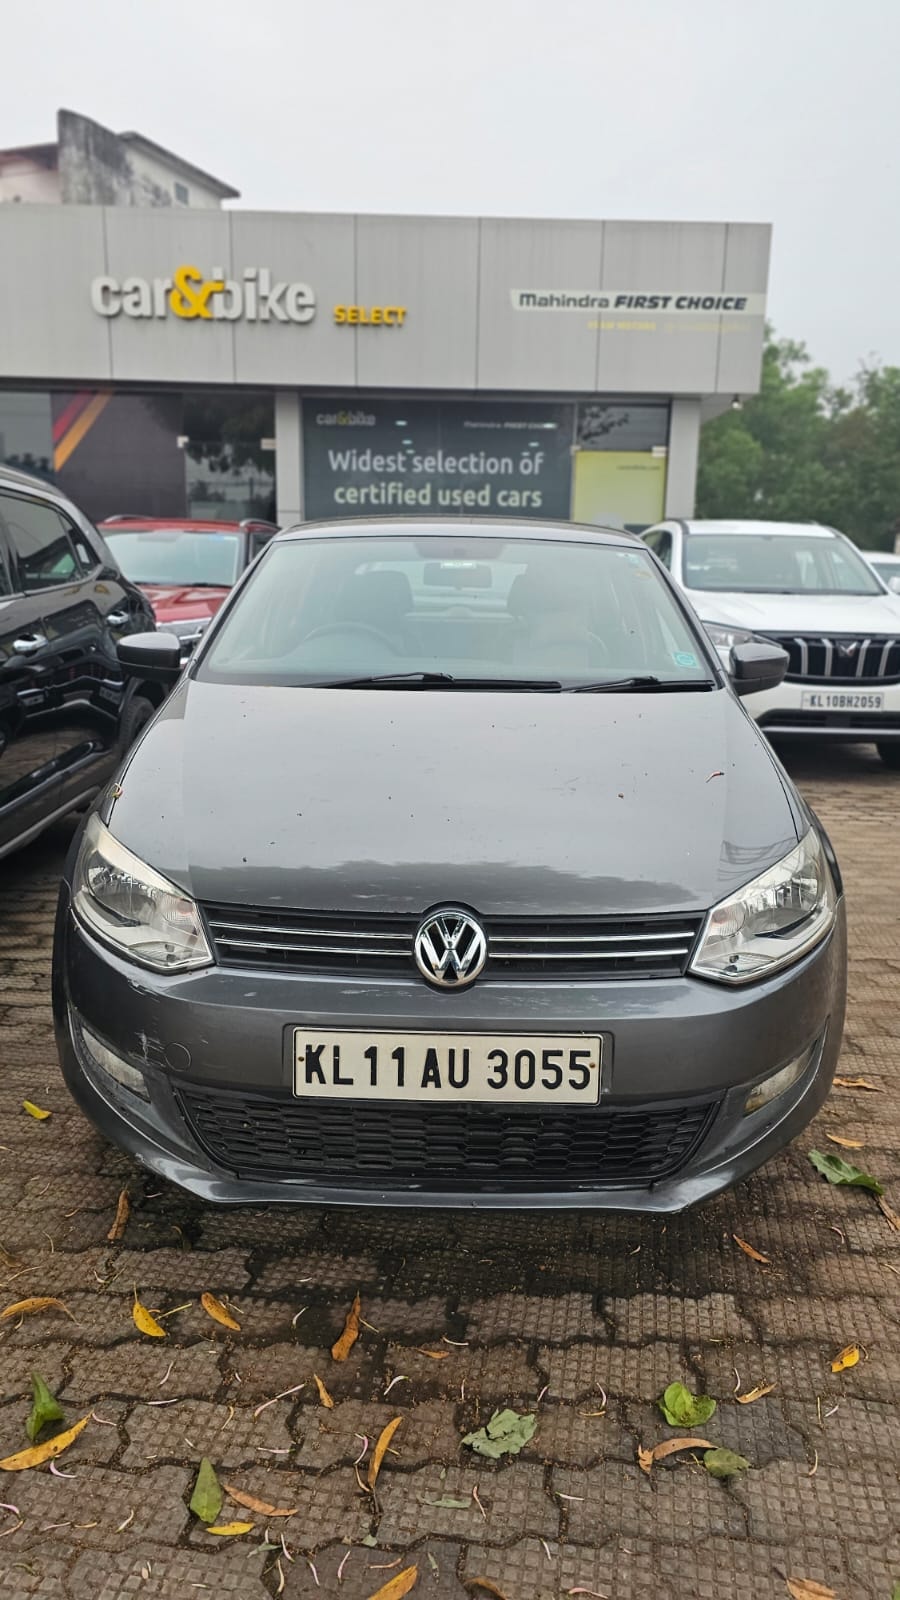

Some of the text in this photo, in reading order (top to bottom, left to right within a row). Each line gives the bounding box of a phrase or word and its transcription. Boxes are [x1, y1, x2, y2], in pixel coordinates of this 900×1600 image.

[91, 265, 317, 324] car&bike
[519, 292, 748, 311] Mahindra FIRST CHOICE
[333, 305, 407, 326] SELECT
[328, 450, 544, 476] Widest selection of
[333, 482, 543, 509] certified used cars
[486, 1048, 592, 1092] 3055
